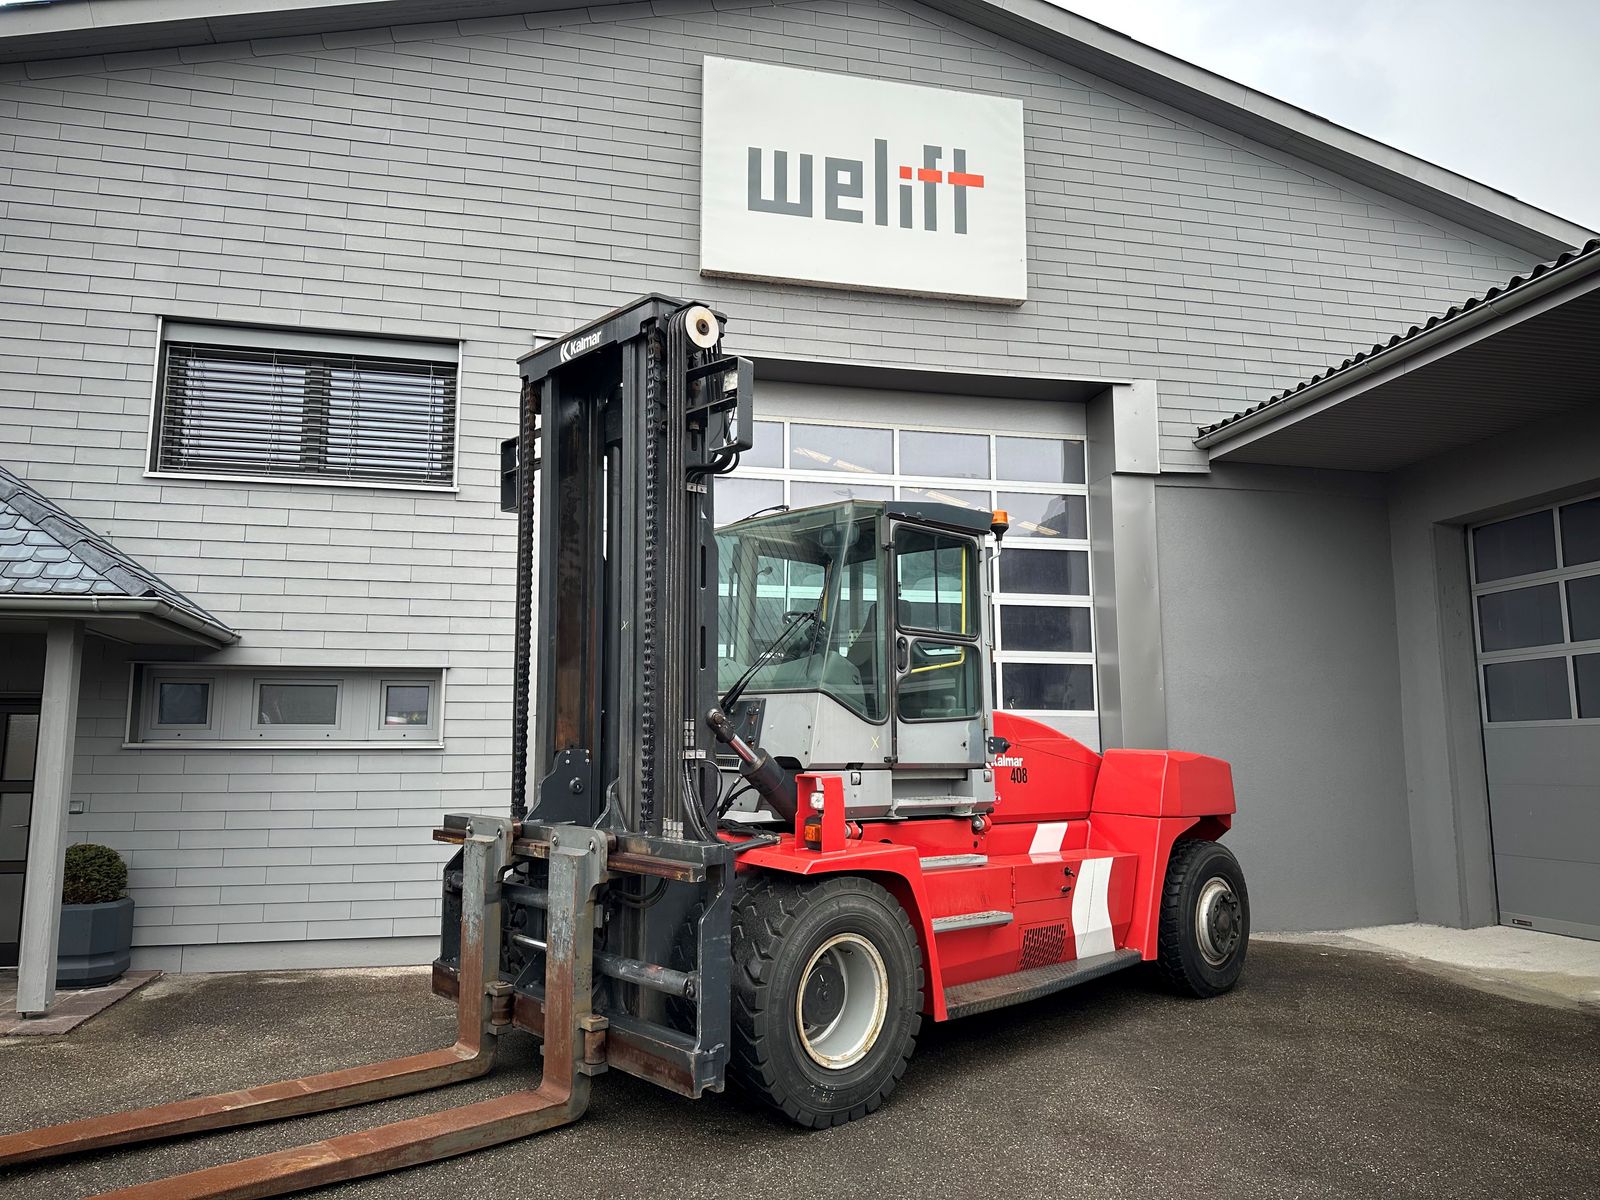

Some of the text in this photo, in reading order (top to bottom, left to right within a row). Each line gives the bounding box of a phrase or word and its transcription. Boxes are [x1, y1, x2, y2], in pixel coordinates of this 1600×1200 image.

[748, 138, 984, 234] welift
[570, 331, 602, 356] Kalmar
[1010, 767, 1028, 784] 408
